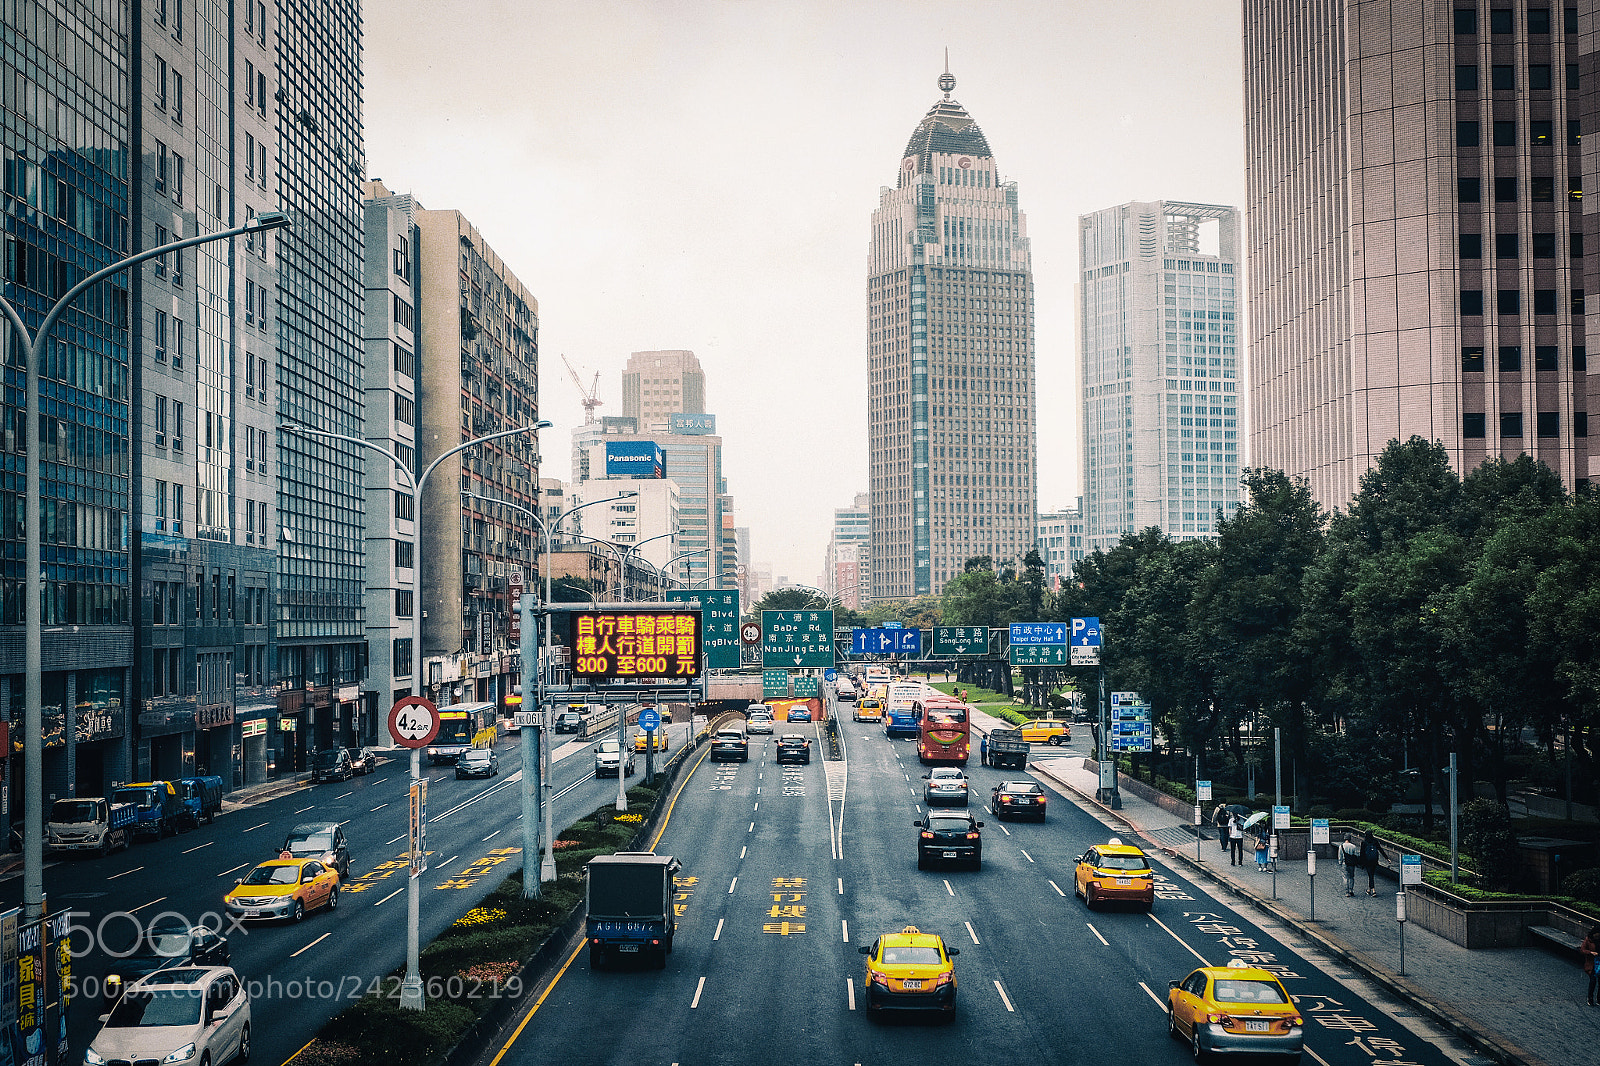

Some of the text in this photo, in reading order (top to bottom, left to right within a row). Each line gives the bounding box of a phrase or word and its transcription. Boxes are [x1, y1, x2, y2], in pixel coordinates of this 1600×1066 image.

[608, 454, 652, 462] Panasonic
[711, 610, 735, 618] Blvd.
[776, 612, 819, 622] 八德路
[578, 614, 696, 635] 自行車騎乘騎
[773, 624, 822, 632] BaDe Rd.
[1072, 618, 1086, 637] P
[939, 628, 983, 638] 松隆路
[1012, 626, 1053, 635] 市政中心
[768, 633, 827, 643] 南京東路
[577, 636, 696, 655] 樓人行道開罰
[818, 645, 832, 653] Rd.
[1015, 647, 1051, 656] 仁愛路
[577, 657, 608, 673] 300
[676, 656, 696, 674] 元
[398, 713, 417, 730] 4.2
[526, 712, 541, 725] 061
[1290, 994, 1425, 1066] 公車停
